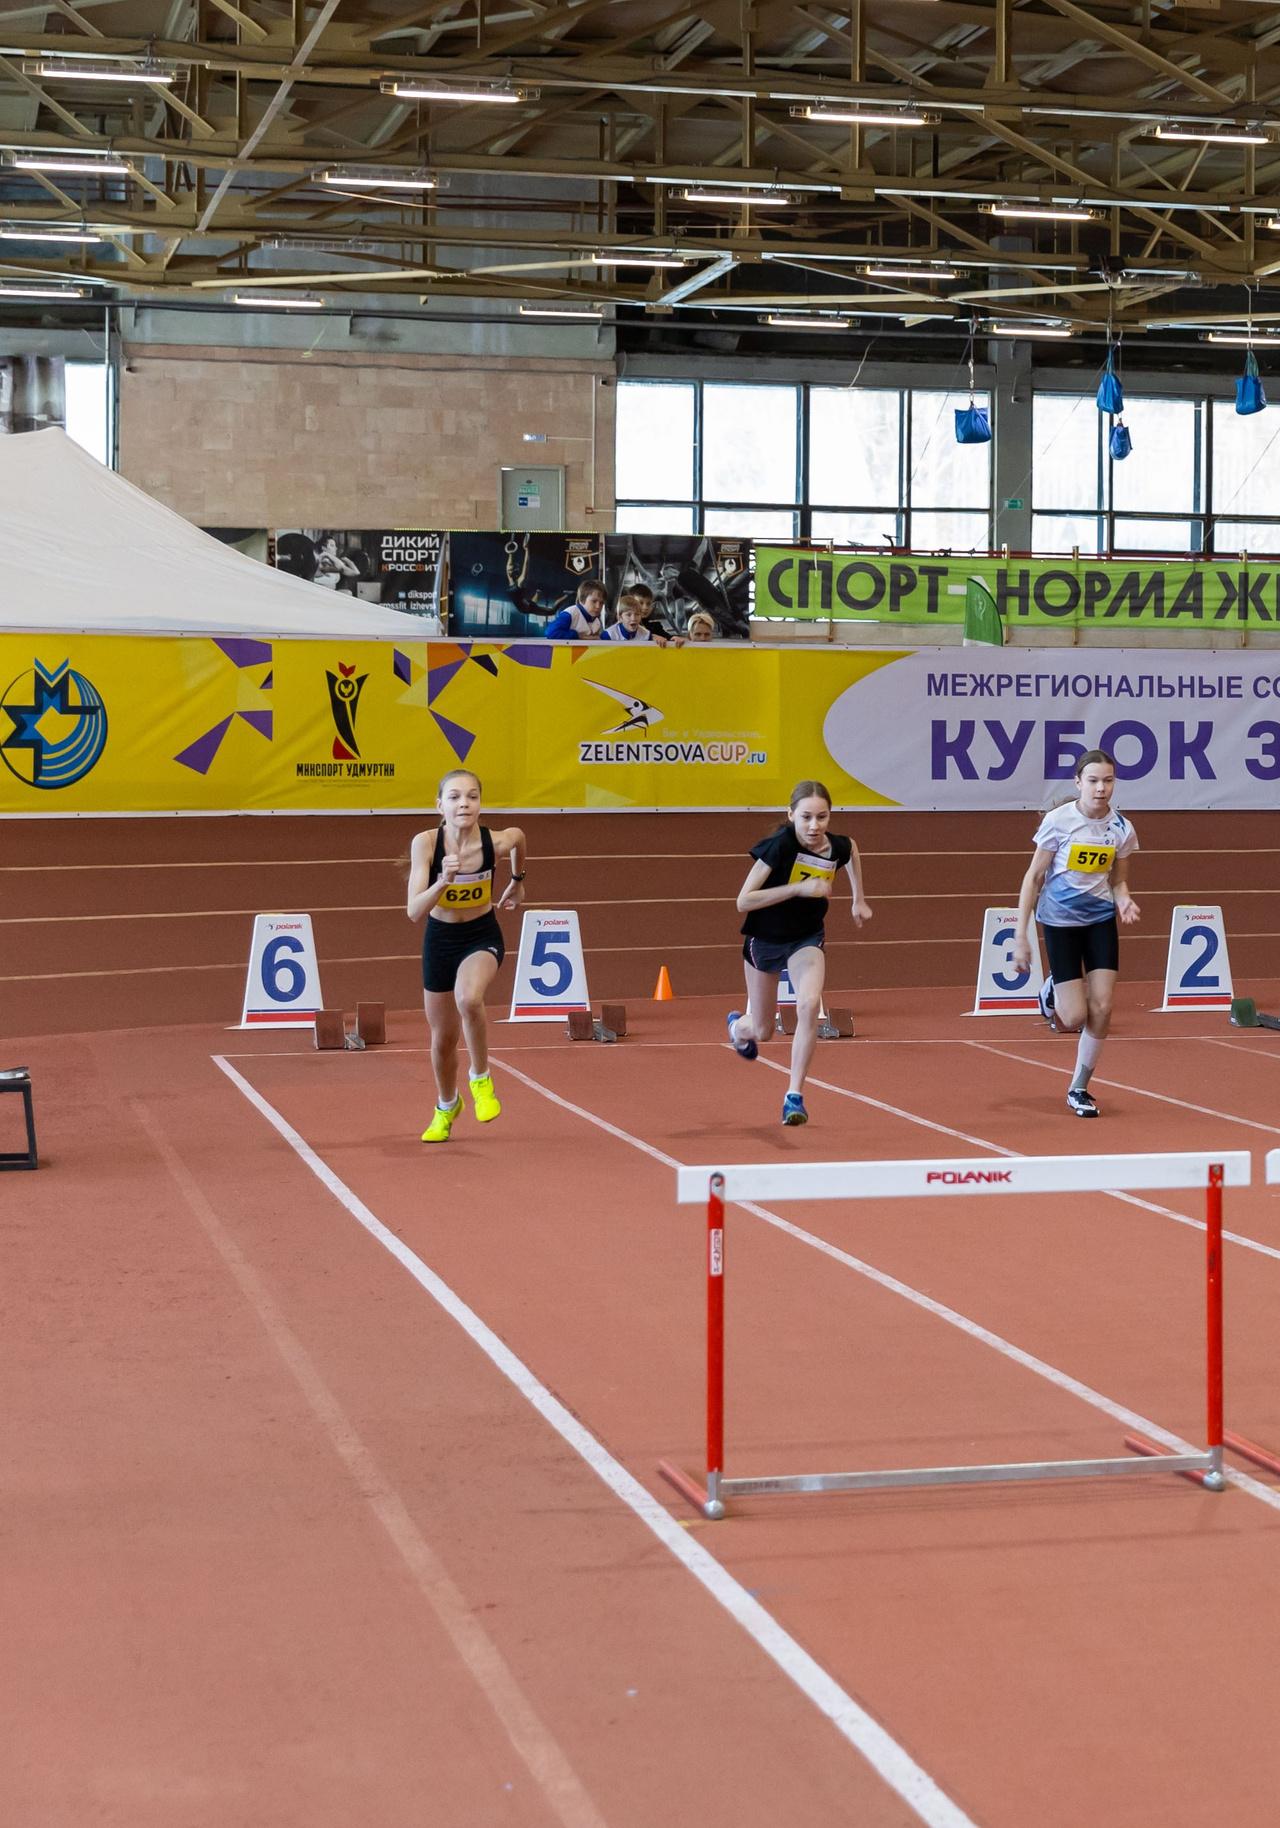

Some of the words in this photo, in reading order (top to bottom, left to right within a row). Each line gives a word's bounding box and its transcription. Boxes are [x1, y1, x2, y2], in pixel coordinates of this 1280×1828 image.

[380, 533, 439, 548] ДИКИЙ
[381, 563, 439, 572] КРОССФИТ
[382, 549, 439, 562] СПОРТ
[768, 557, 947, 613] СПОРТ
[997, 569, 1203, 620] НОРМА
[928, 674, 1242, 699] МЕЖРЕГИОНАЛЬНЫЕ
[932, 720, 1216, 780] КУБОК
[1077, 851, 1108, 865] 576
[446, 887, 483, 902] 620
[529, 931, 573, 996] 5
[991, 928, 1031, 991] 3
[1180, 925, 1219, 987] 2
[261, 936, 306, 1002] 6
[927, 1170, 1012, 1184] POLANIK
